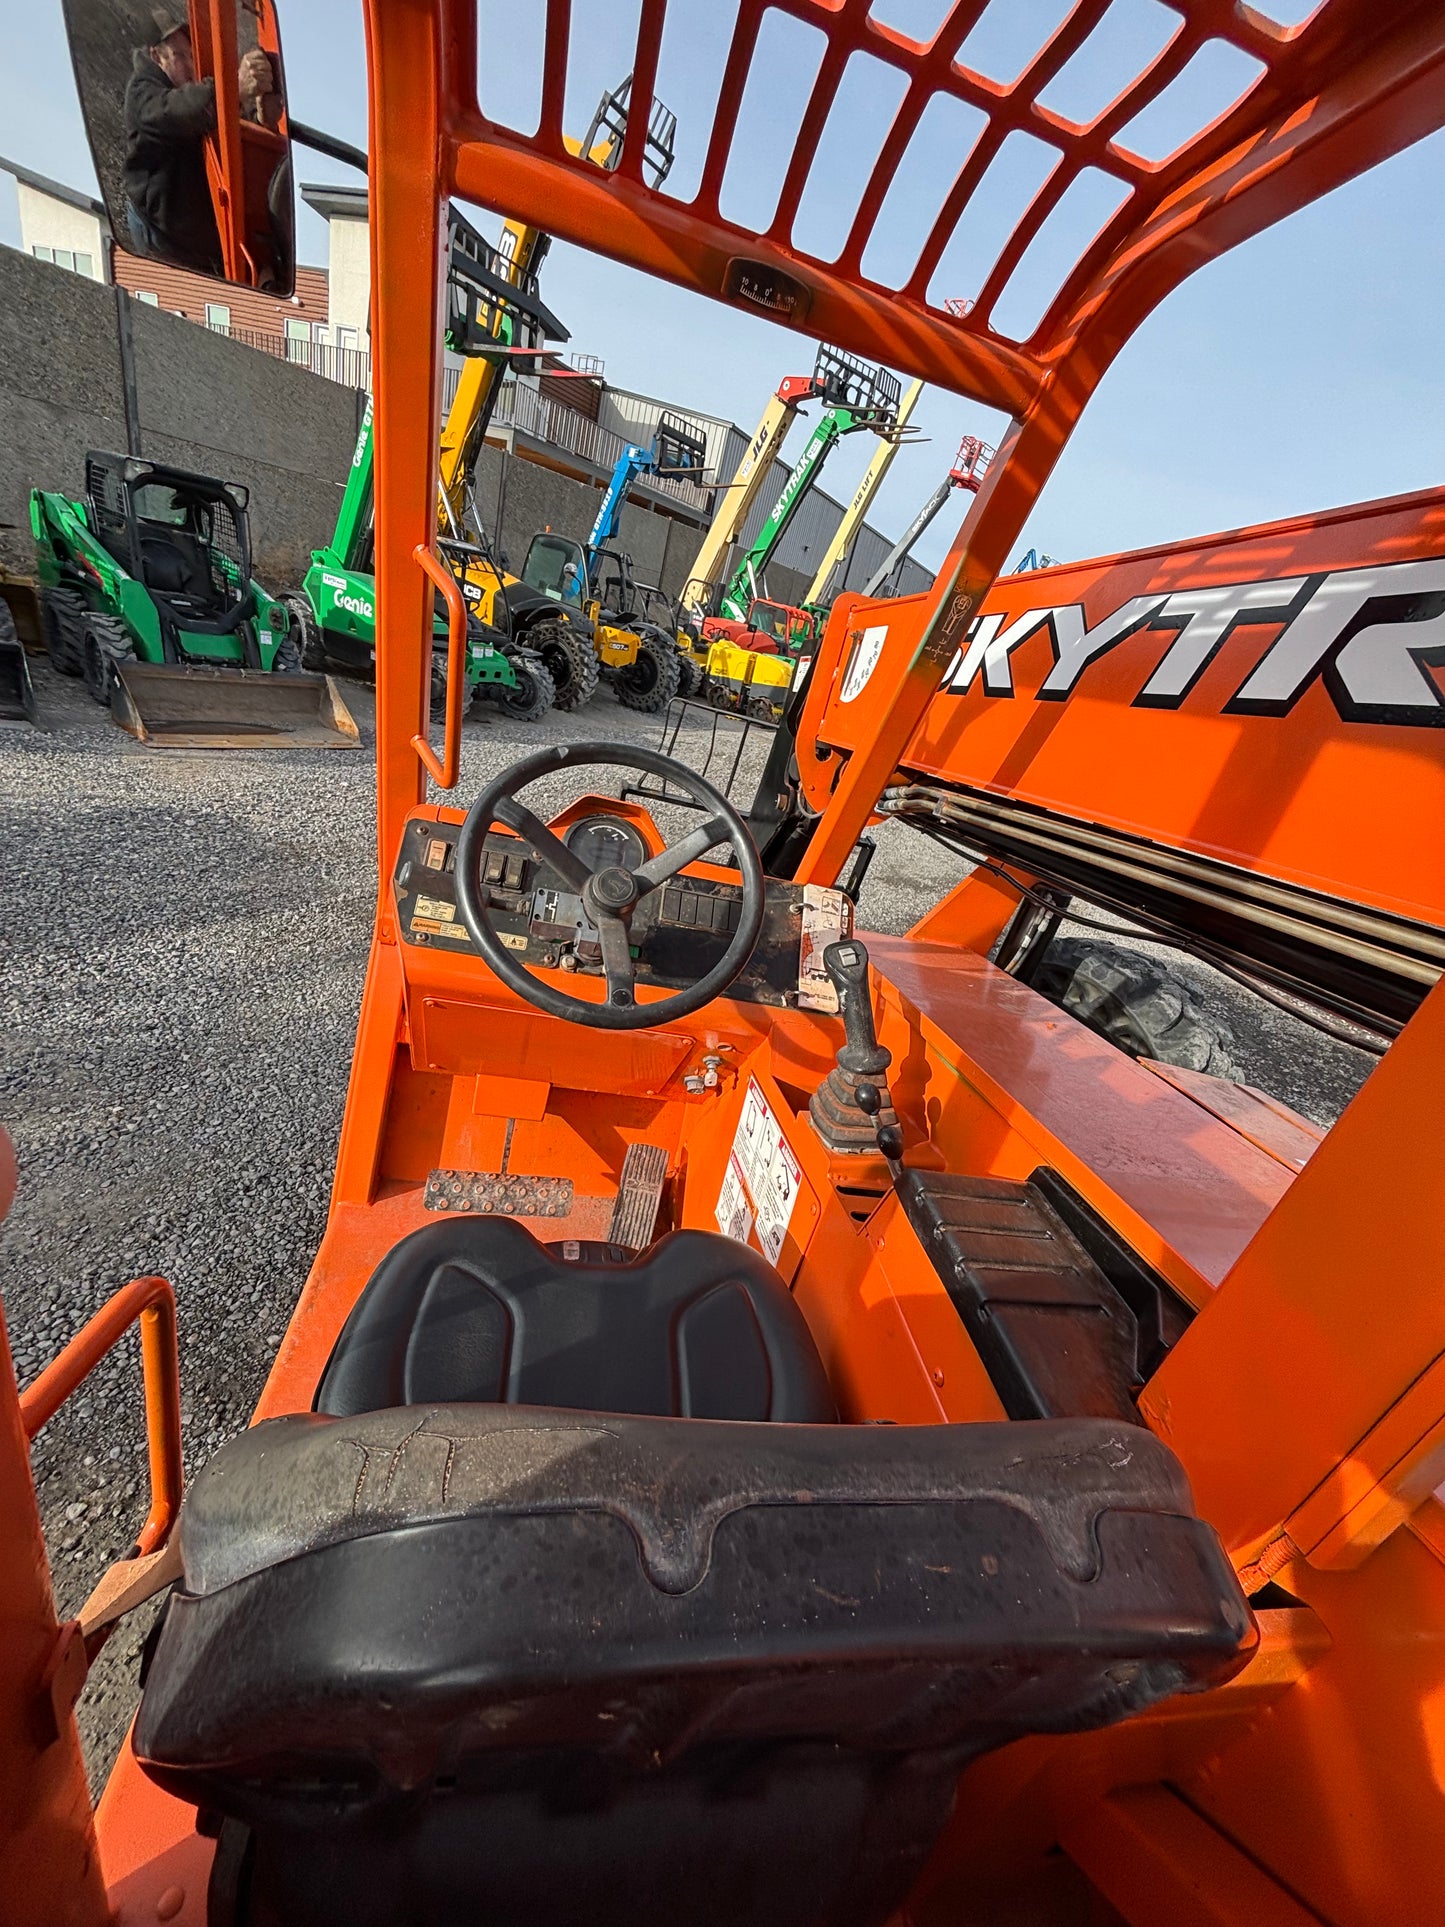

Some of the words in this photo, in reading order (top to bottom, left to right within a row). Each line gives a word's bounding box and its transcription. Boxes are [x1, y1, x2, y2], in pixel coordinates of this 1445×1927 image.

[352, 430, 369, 468] Genie
[752, 424, 768, 463] JLG
[771, 453, 810, 523] SKYTRAK
[853, 491, 863, 510] JLG
[861, 469, 874, 492] LIFT
[911, 490, 941, 533] SKYJACK
[333, 588, 373, 618] Genie
